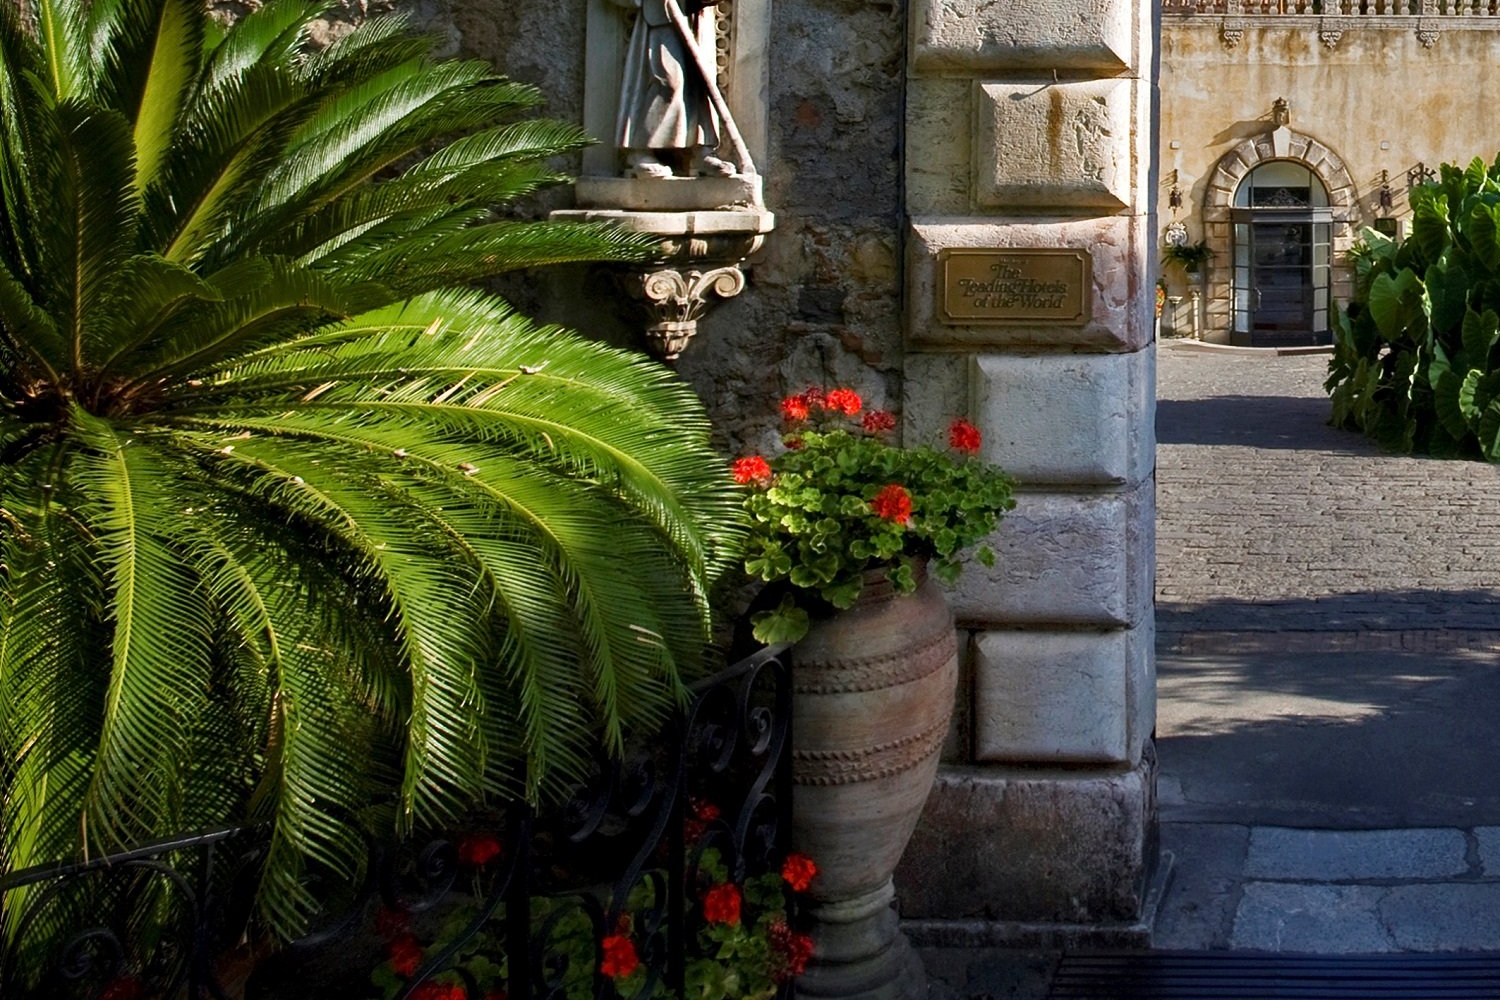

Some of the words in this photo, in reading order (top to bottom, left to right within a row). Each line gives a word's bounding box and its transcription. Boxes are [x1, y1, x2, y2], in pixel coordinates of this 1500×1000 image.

[991, 264, 1022, 279] The
[959, 278, 1016, 297] Leading
[1015, 278, 1068, 294] Hotels
[974, 294, 990, 308] of
[992, 294, 1014, 308] the
[1014, 293, 1065, 310] World
